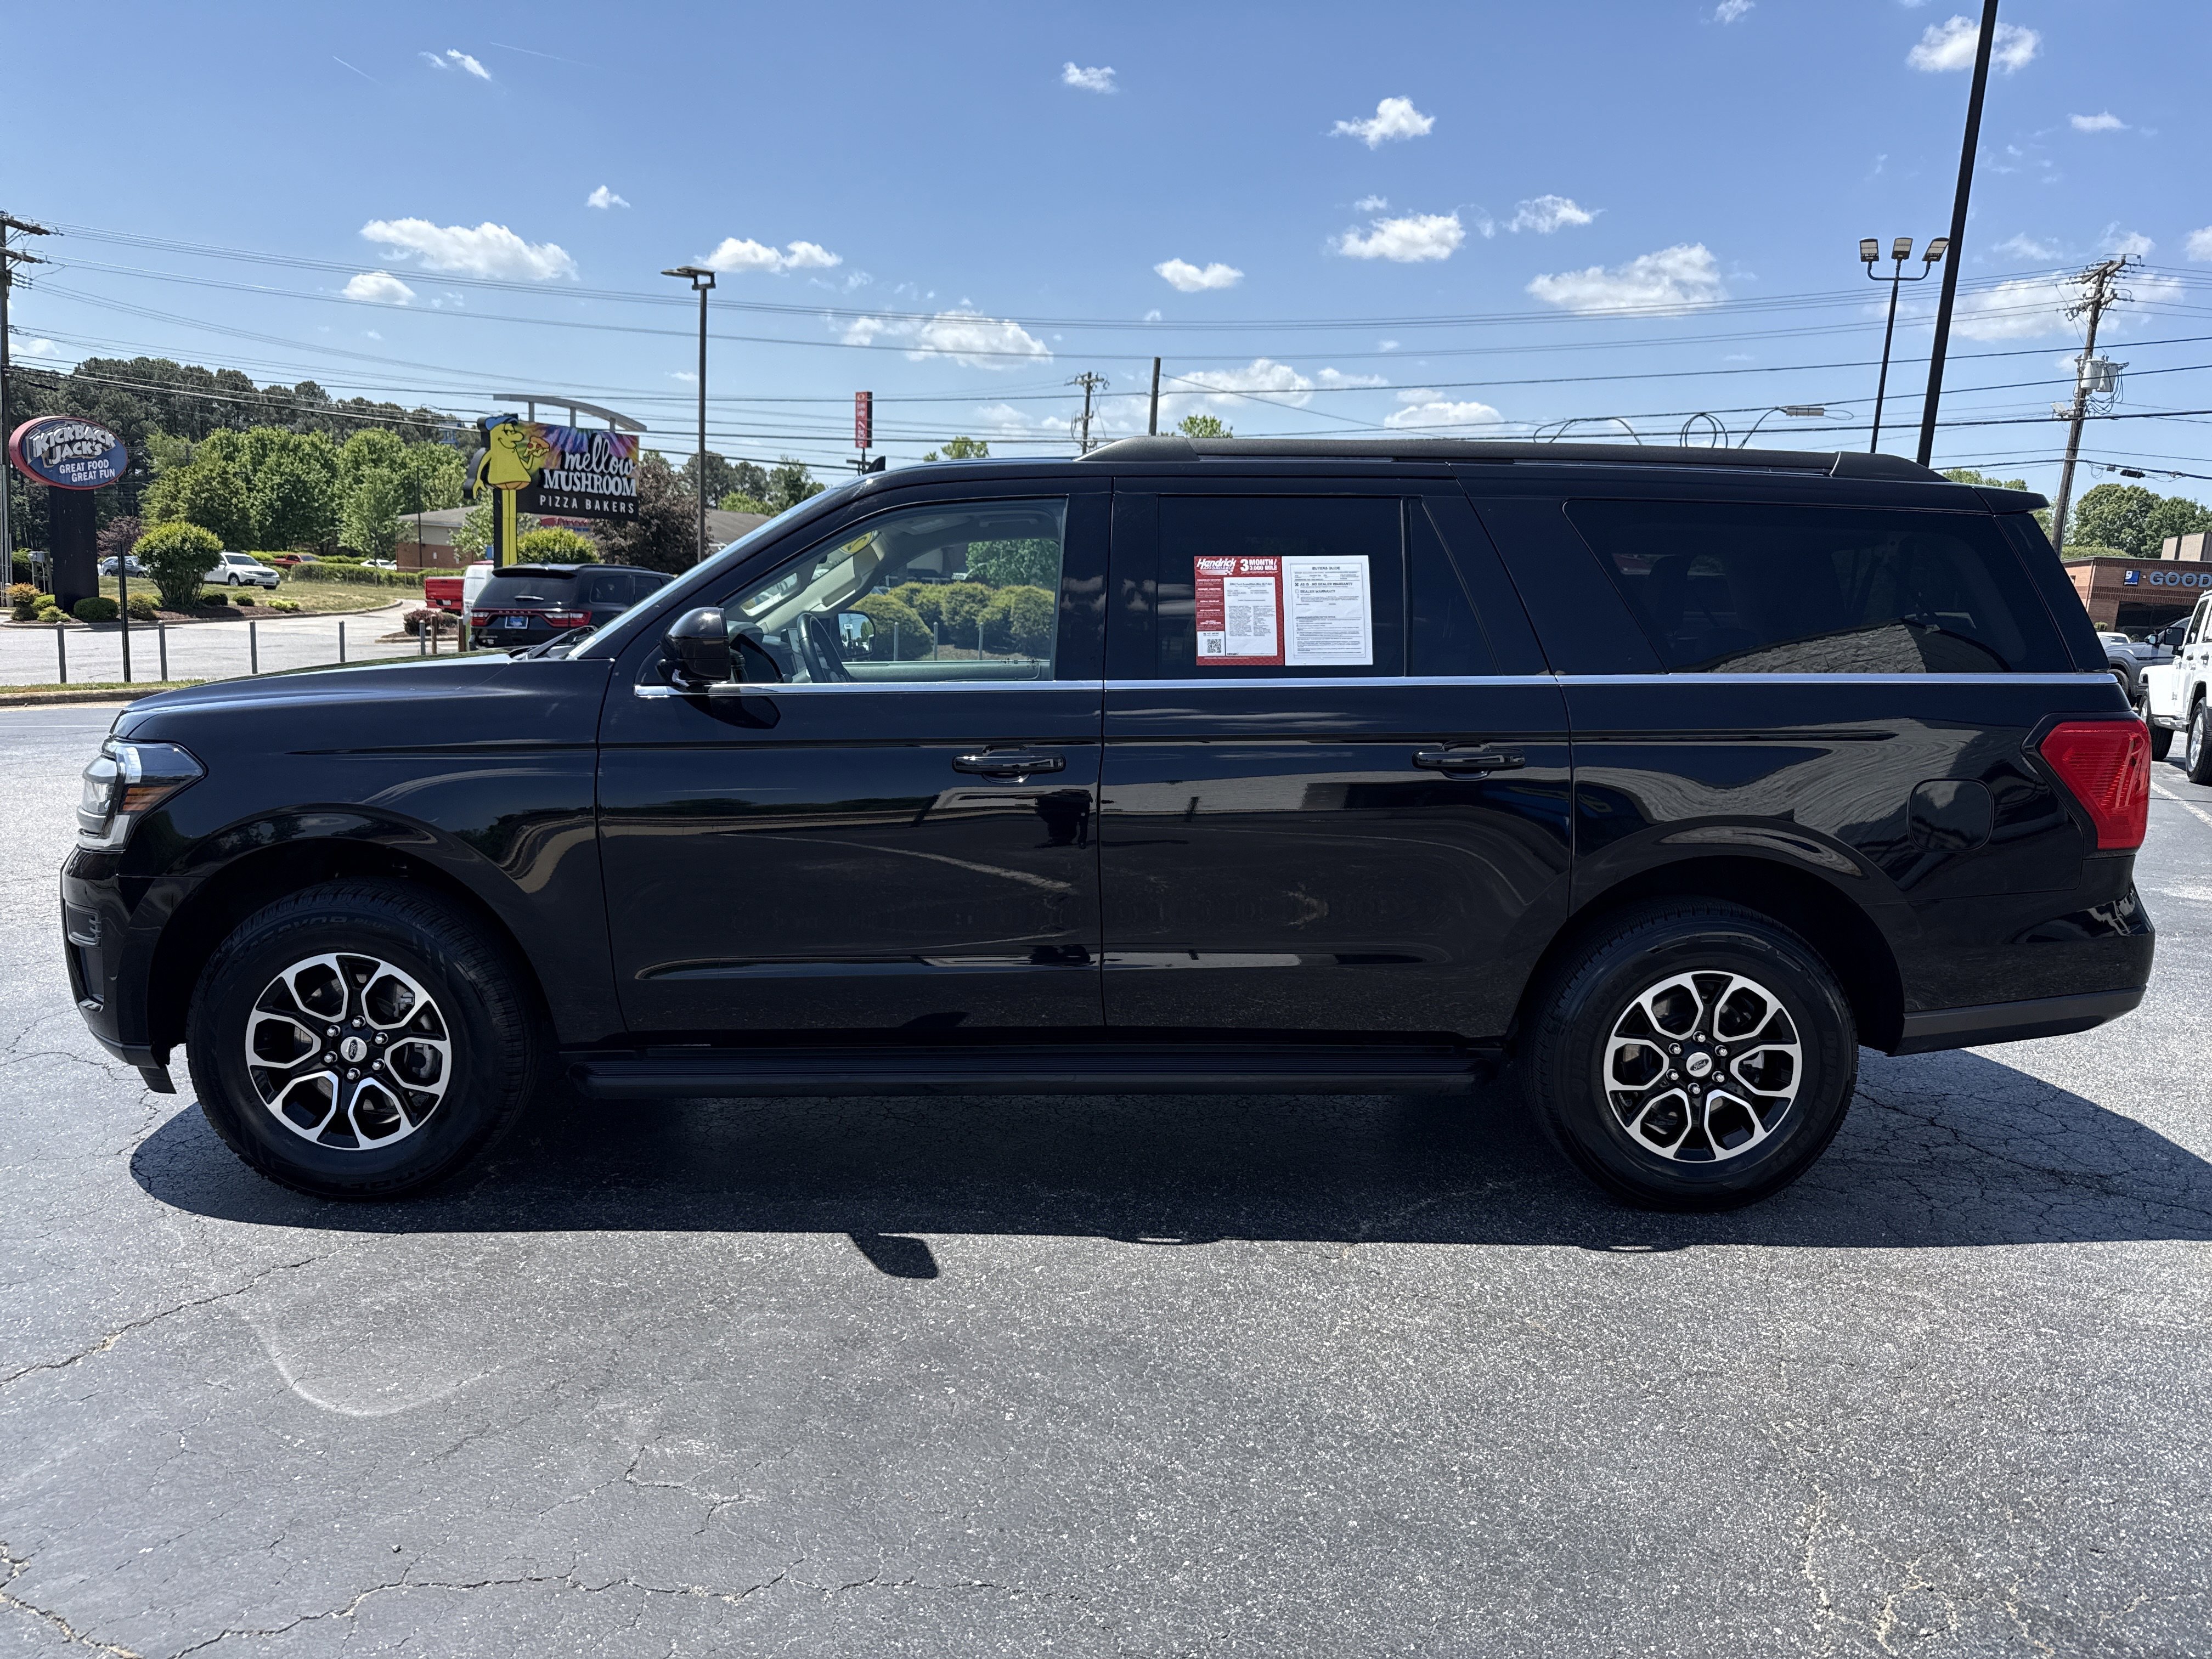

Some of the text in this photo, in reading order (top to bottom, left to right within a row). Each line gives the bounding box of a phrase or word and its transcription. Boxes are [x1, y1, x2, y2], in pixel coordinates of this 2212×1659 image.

[51, 441, 102, 464] JACK'S
[565, 433, 637, 476] mellow
[59, 459, 109, 474] GREAT FOOD
[71, 469, 115, 482] GREAT FUN
[543, 469, 637, 497] MUSHROOM
[539, 494, 634, 514] PIZZA BAKERS
[1197, 558, 1237, 569] Hendrick
[1240, 559, 1249, 571] 3
[1693, 1060, 1706, 1070] Ford
